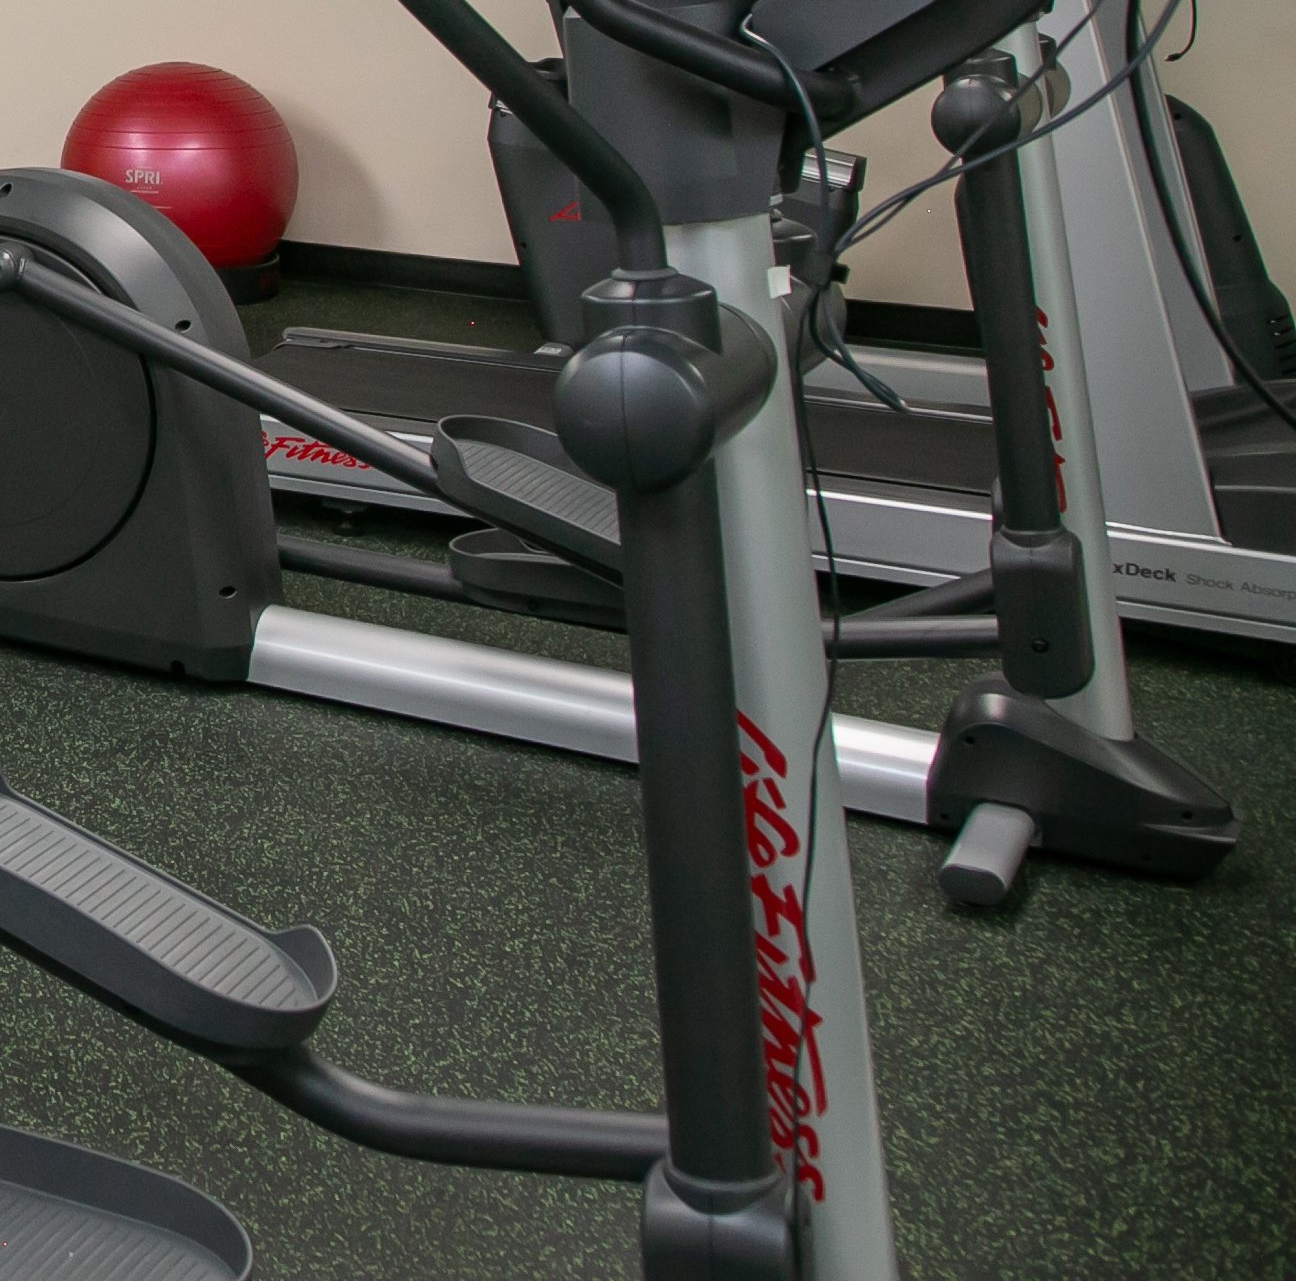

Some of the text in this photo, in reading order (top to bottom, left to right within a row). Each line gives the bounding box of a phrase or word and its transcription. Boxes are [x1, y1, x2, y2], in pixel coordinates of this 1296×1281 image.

[125, 169, 161, 185] SPRI
[1112, 562, 1296, 601] xDeck Shock Absorp
